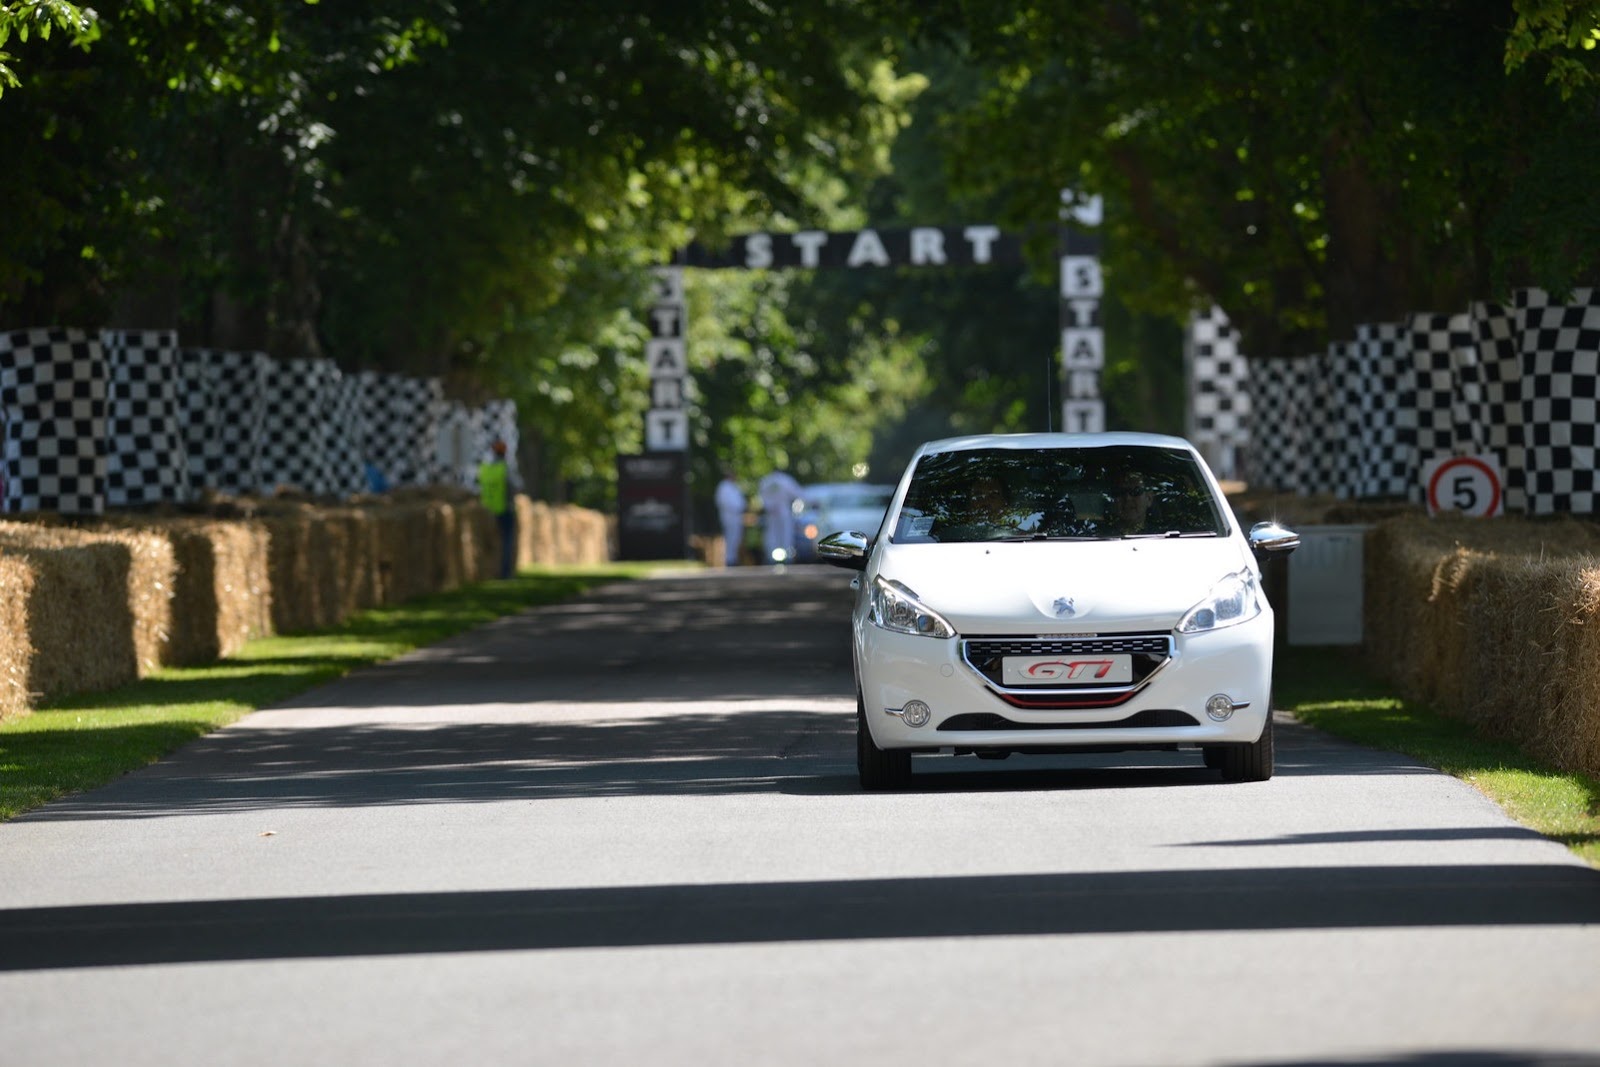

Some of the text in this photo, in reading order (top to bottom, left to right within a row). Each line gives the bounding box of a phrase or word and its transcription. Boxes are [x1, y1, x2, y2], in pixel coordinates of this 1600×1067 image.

[744, 225, 1001, 268] START
[1067, 266, 1099, 433] START
[1453, 477, 1477, 511] 5
